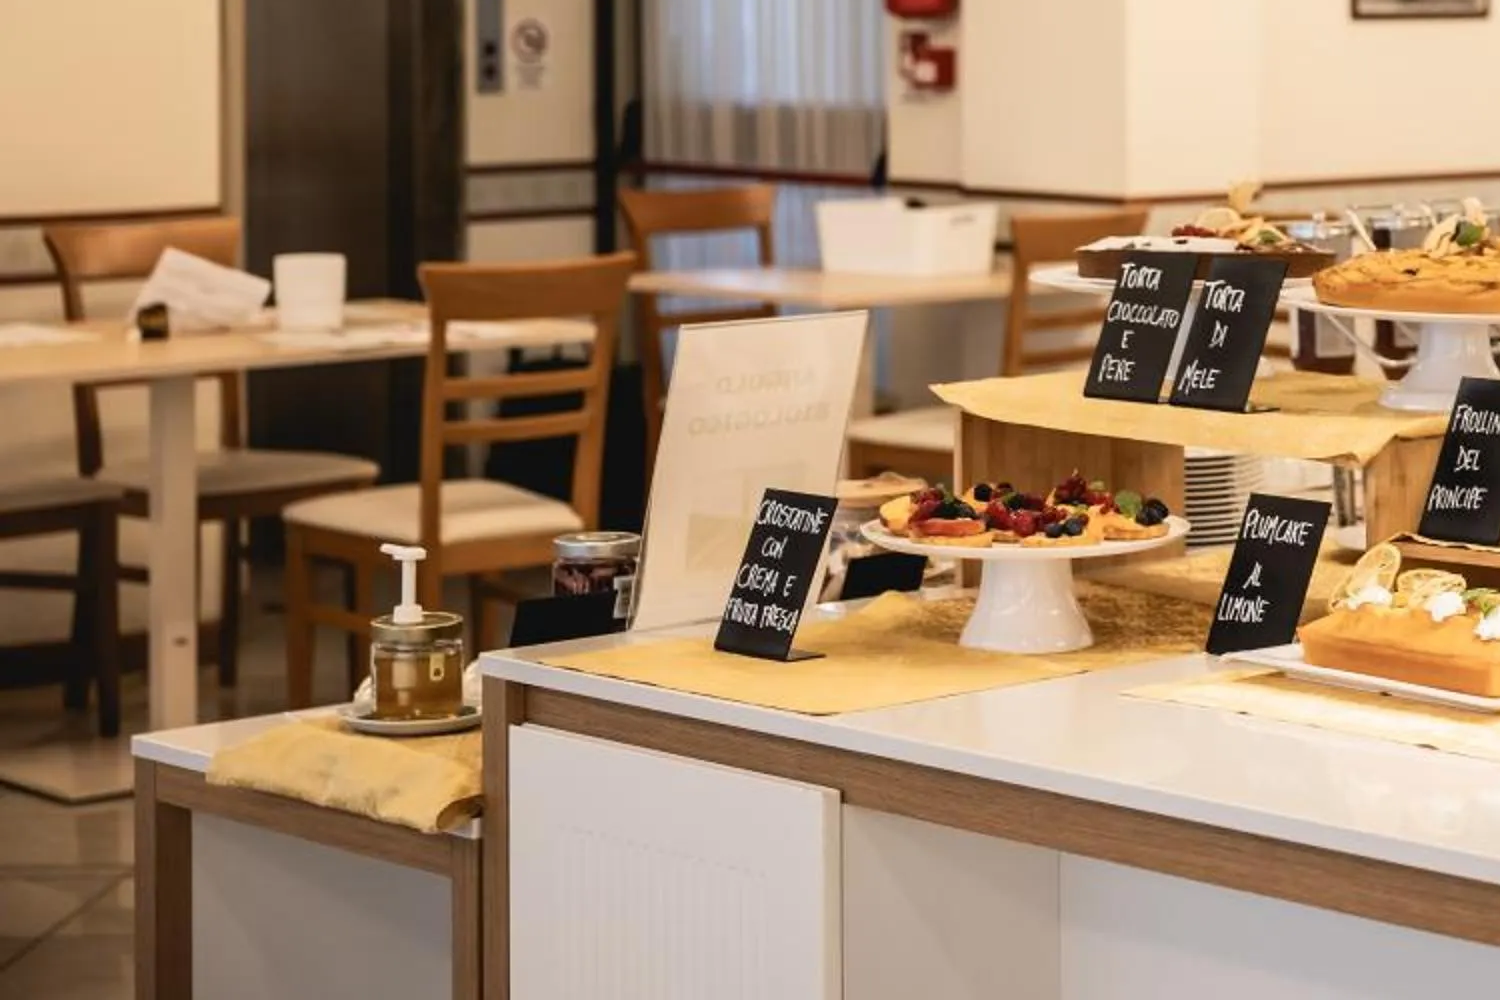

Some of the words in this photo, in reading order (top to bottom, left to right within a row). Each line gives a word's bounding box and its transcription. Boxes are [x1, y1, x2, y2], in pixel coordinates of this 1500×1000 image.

[1120, 262, 1162, 289] TORTA
[1205, 280, 1245, 312] TORTA
[1108, 301, 1180, 328] CIOCCOLATO
[1121, 330, 1135, 349] E
[1210, 321, 1228, 348] DI
[1098, 354, 1135, 382] PERE
[1178, 360, 1221, 395] MELE
[1455, 446, 1480, 472] DEL
[1428, 485, 1488, 510] PRINCIPE
[757, 499, 829, 535] CROSTATINE
[1242, 508, 1313, 546] PLUMCAKE
[761, 535, 789, 559] CON
[737, 563, 780, 597] CREMA
[783, 575, 797, 597] E
[1243, 562, 1262, 589] AL
[1218, 593, 1270, 623] LIMONE
